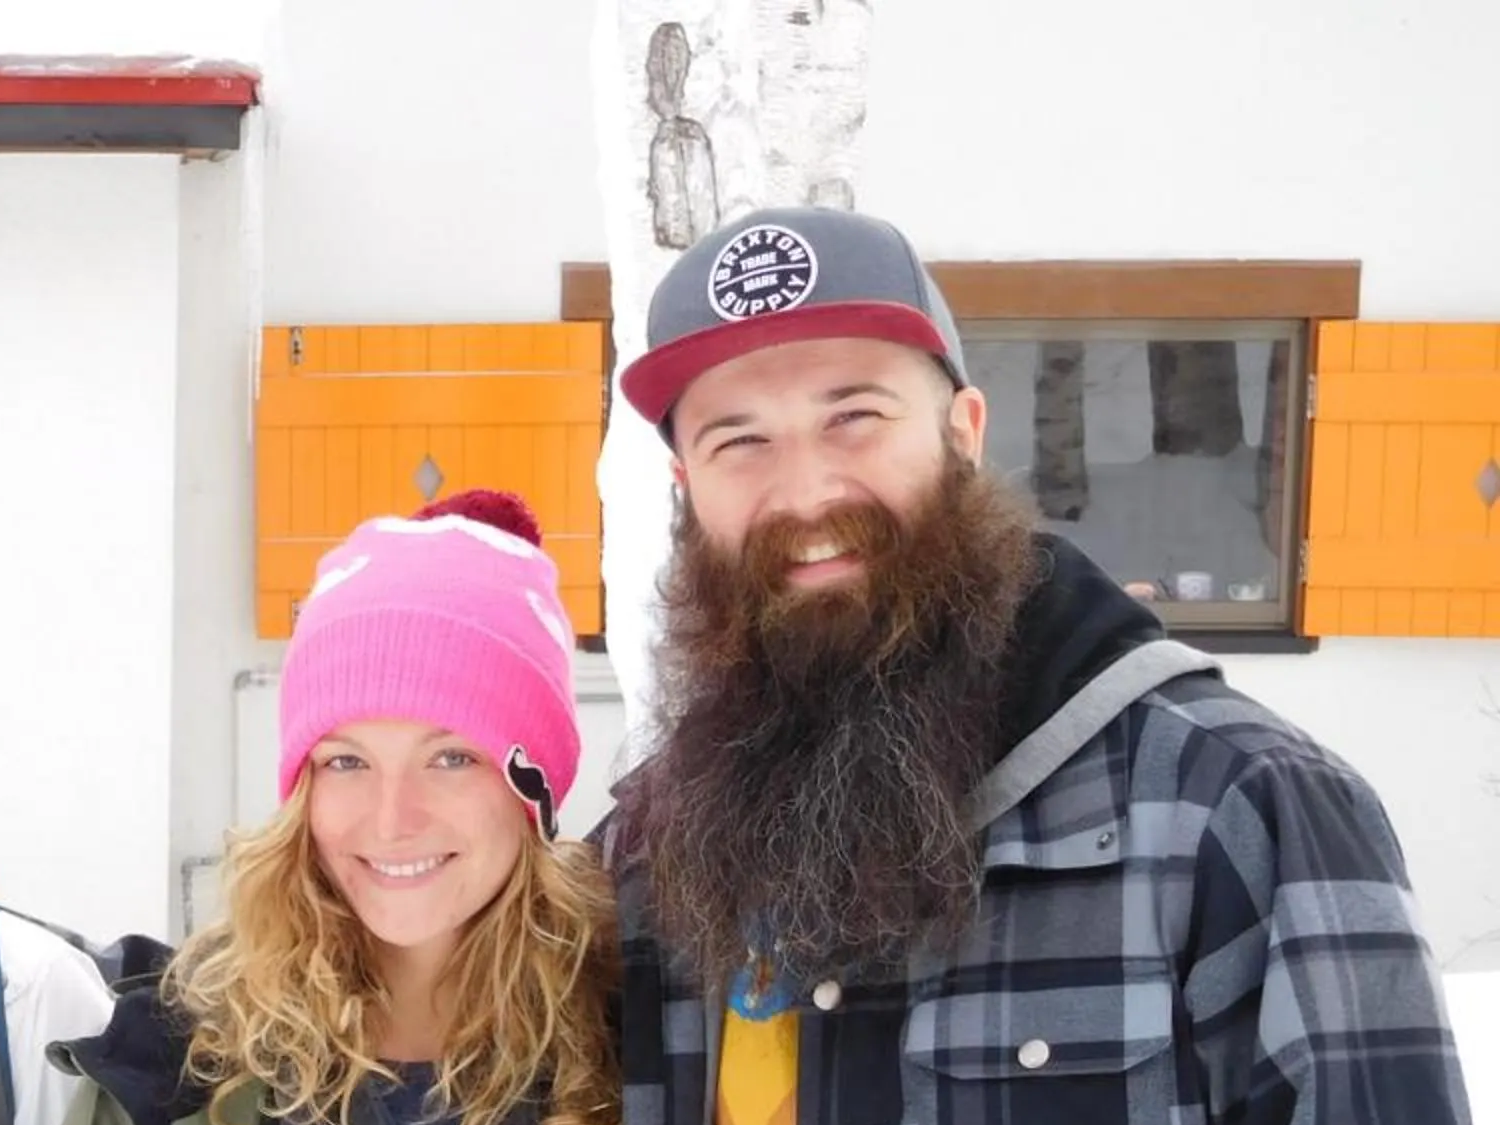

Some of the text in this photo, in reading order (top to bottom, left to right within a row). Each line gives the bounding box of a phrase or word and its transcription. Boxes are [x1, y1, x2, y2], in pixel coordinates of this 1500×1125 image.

[715, 231, 806, 281] BRIXTON
[740, 251, 777, 272] TRADE
[720, 274, 806, 315] SUPPLY
[743, 273, 779, 293] MARK
